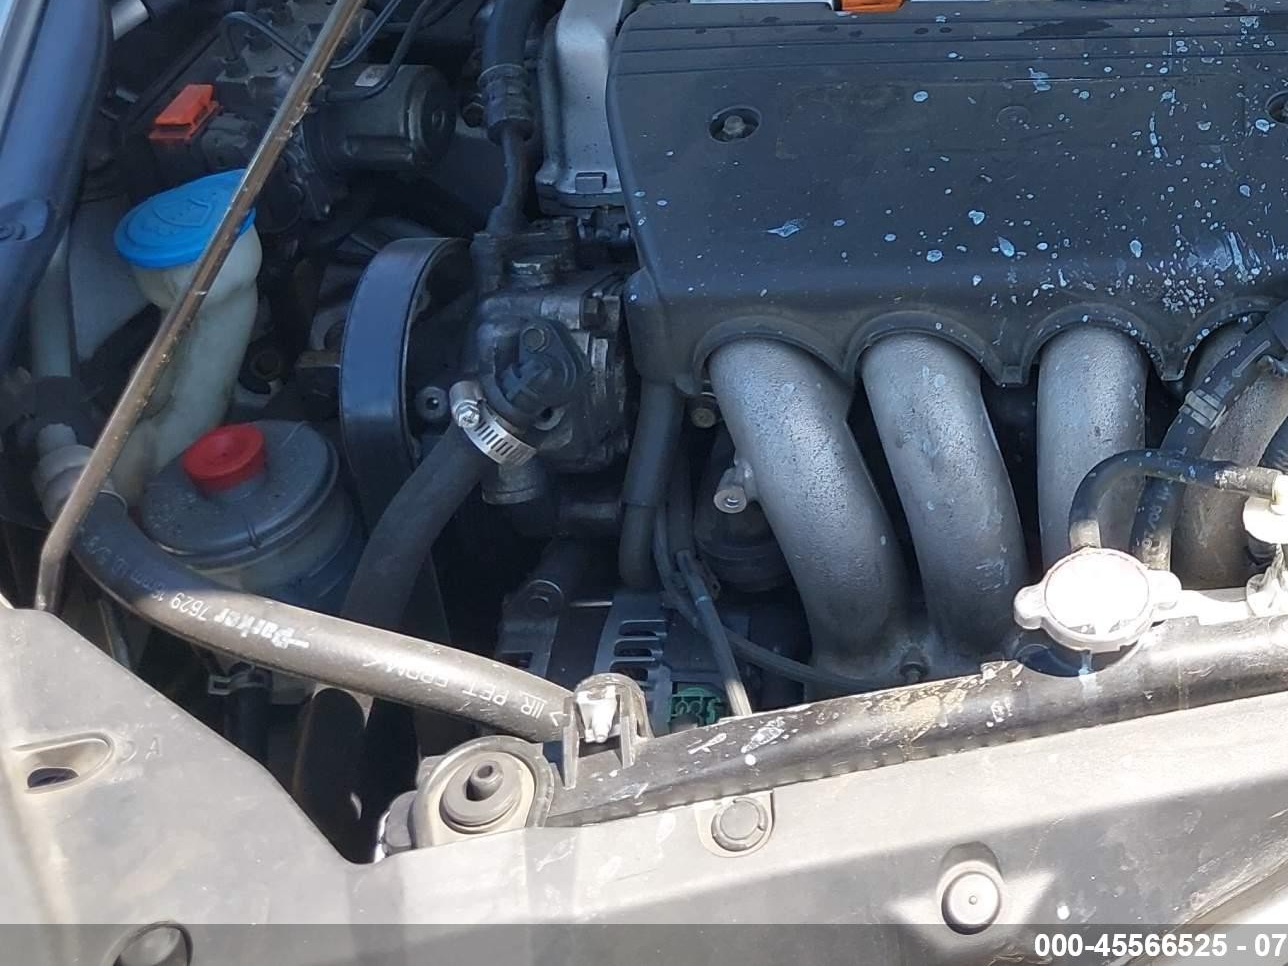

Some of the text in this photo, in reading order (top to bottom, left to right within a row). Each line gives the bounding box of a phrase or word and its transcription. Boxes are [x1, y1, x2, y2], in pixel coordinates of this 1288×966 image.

[170, 592, 211, 621] 7629
[214, 608, 308, 649] Parker
[461, 683, 509, 706] PET
